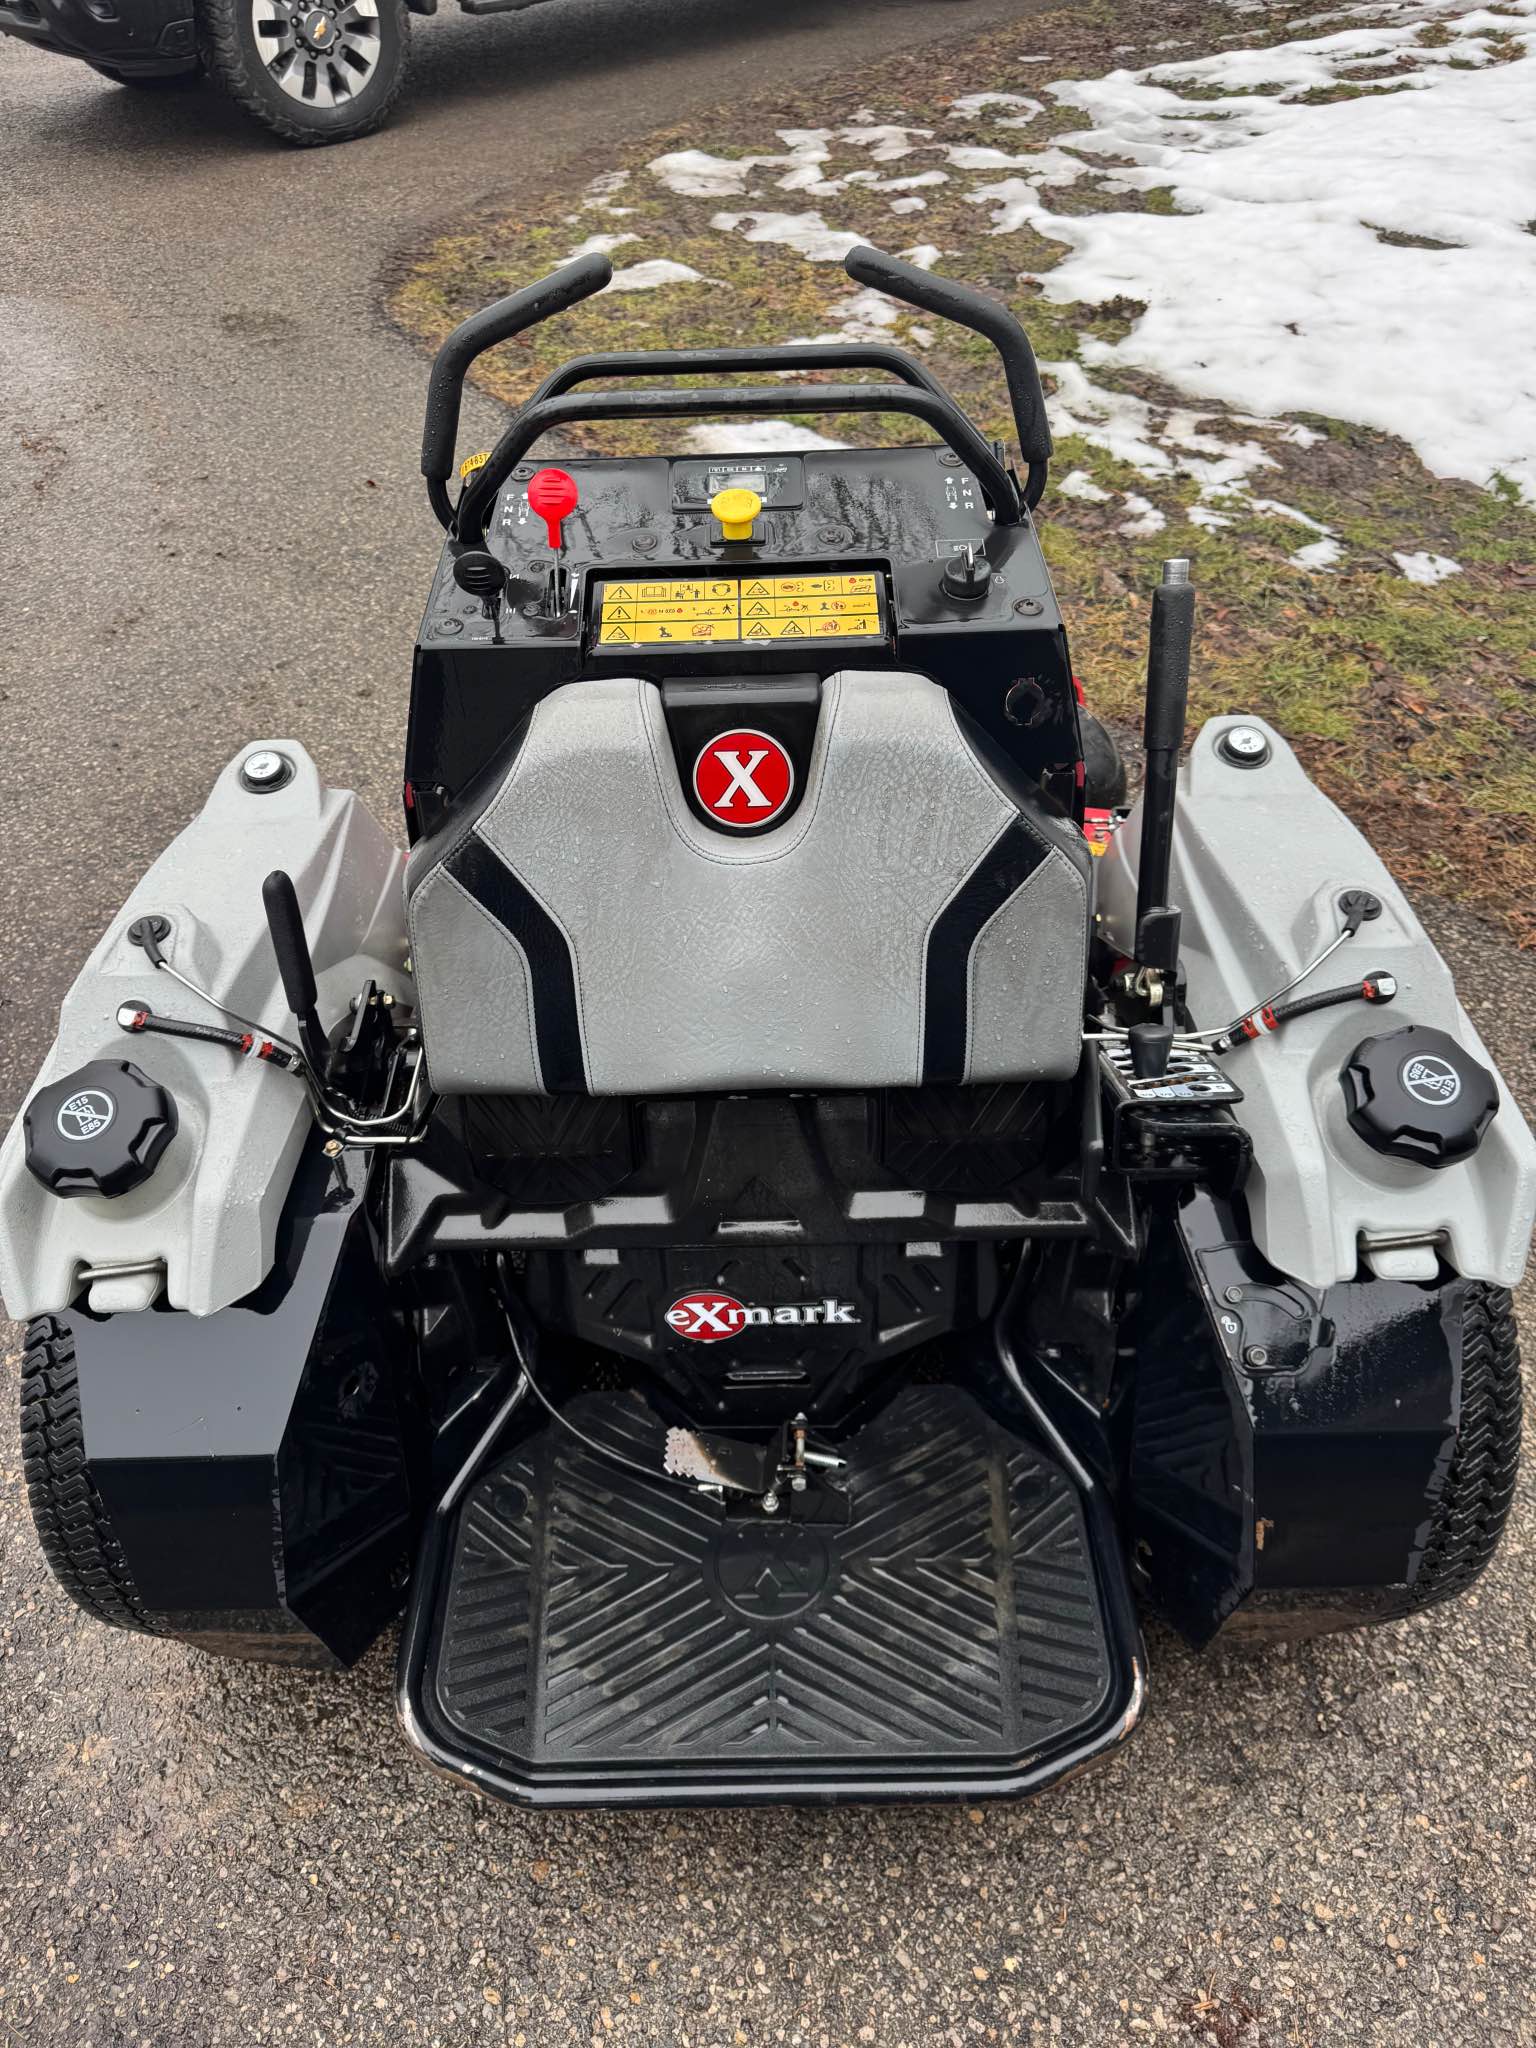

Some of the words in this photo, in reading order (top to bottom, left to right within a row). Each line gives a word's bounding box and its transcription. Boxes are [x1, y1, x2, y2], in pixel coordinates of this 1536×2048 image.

[713, 751, 773, 808] X
[1409, 1063, 1425, 1080] E85
[1440, 1079, 1455, 1096] E15
[69, 1096, 89, 1111] E15
[81, 1120, 102, 1134] E85
[666, 1300, 856, 1334] eXmark
